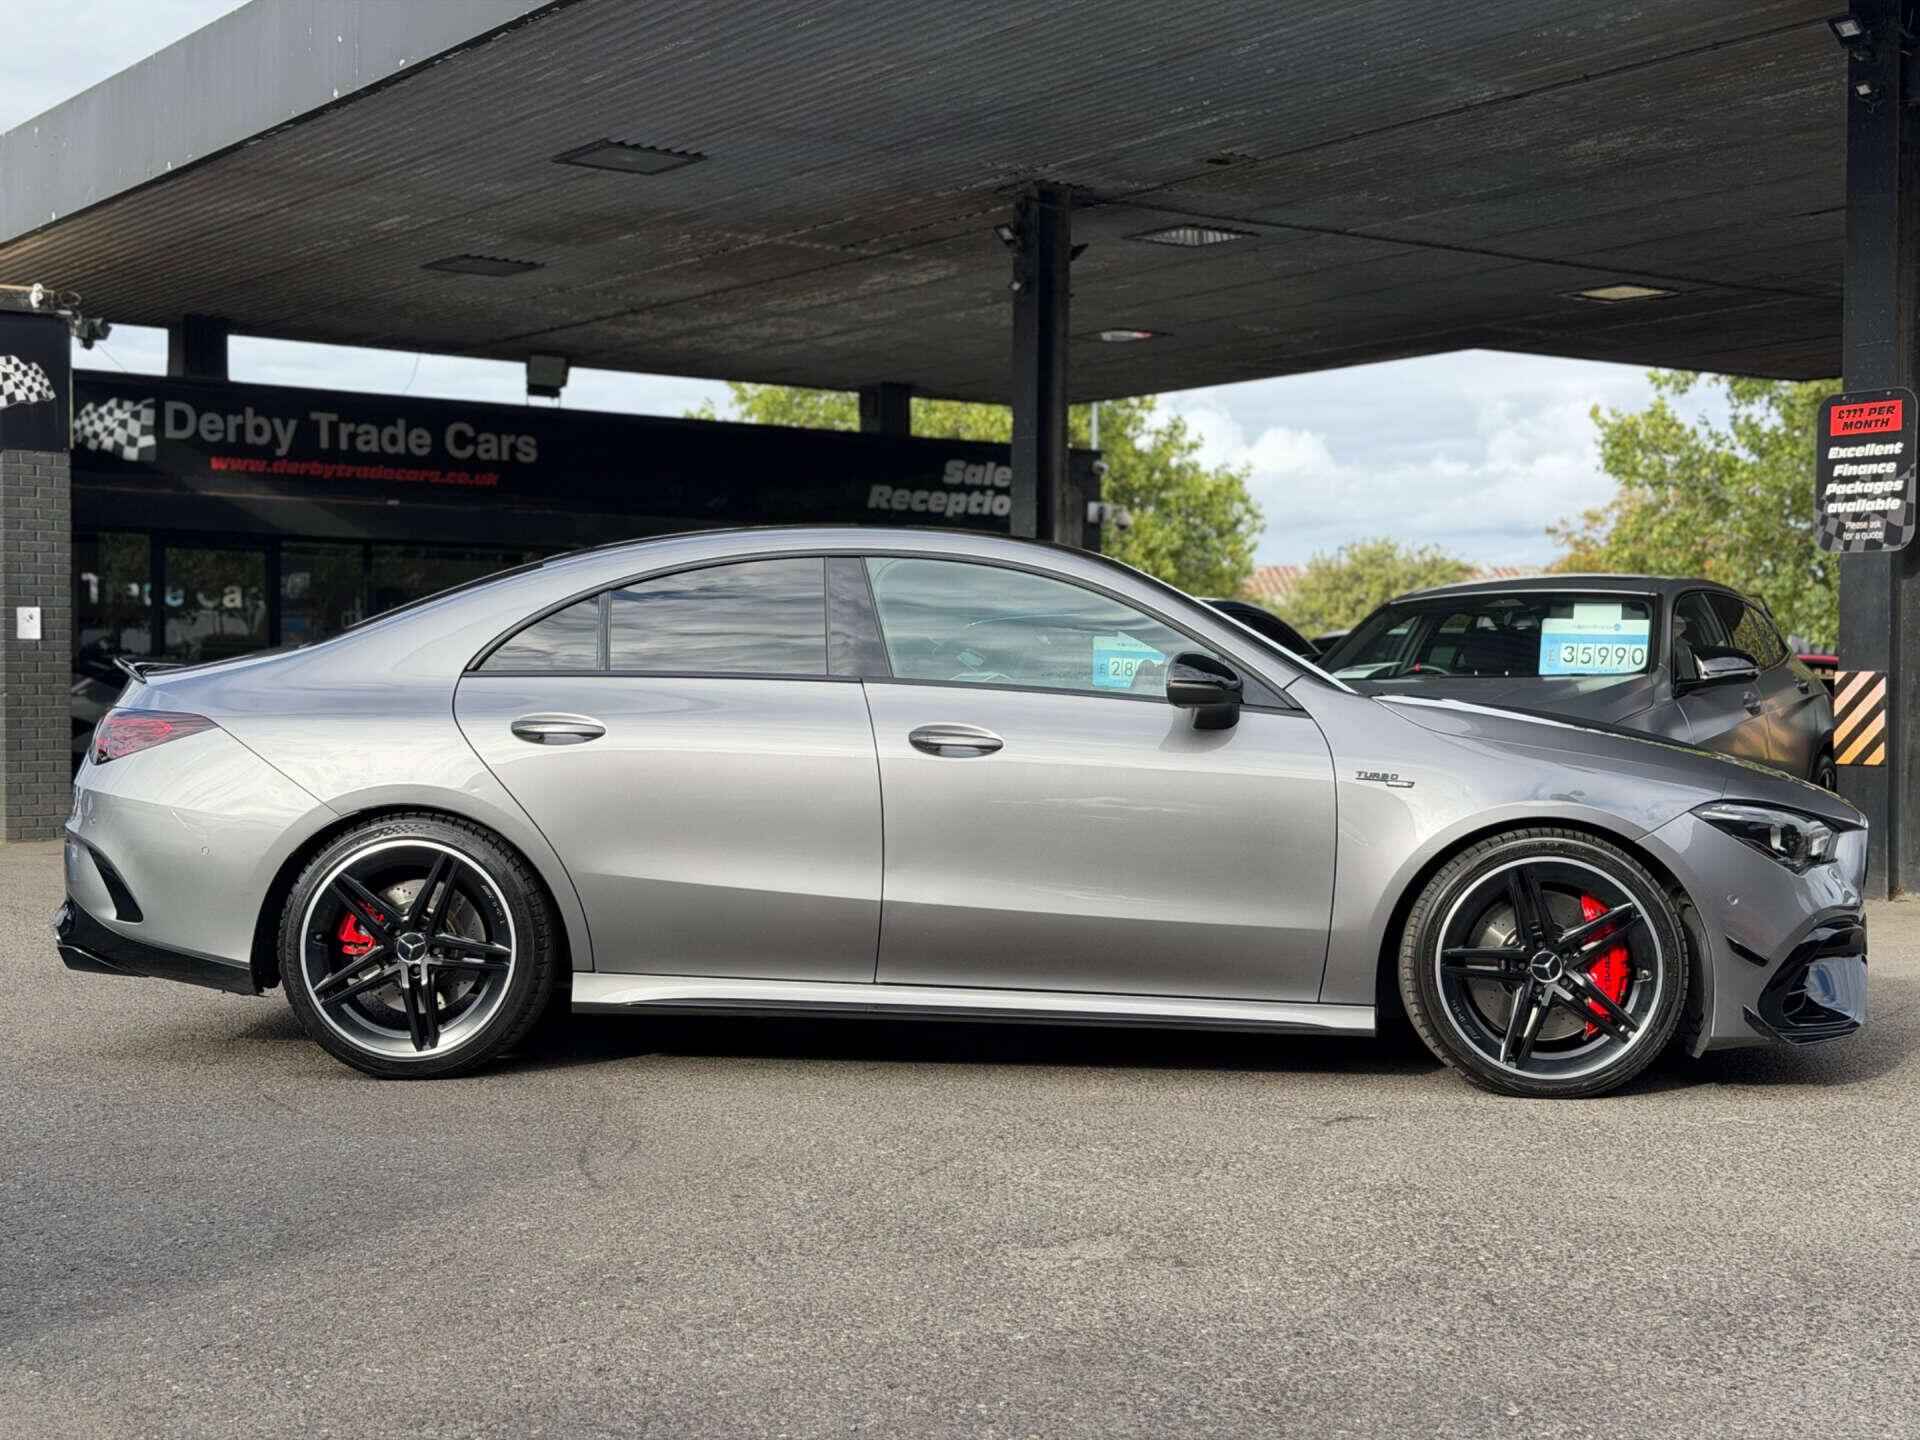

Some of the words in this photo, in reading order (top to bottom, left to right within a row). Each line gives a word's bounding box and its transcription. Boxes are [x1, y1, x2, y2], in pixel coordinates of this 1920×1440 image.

[1868, 405, 1896, 416] PER
[164, 401, 298, 457] Derby
[310, 410, 433, 456] Trade
[444, 420, 539, 463] Cars
[1842, 418, 1890, 431] MONTH
[1828, 441, 1904, 459] Excellent
[210, 455, 499, 487] www.derbytradecars.co.uk
[942, 459, 1013, 488] Sale
[1833, 461, 1897, 478] Finance
[1825, 479, 1904, 496] Packages
[867, 484, 1012, 517] Receptio
[1827, 498, 1901, 514] available
[1356, 770, 1399, 781] TURBO
